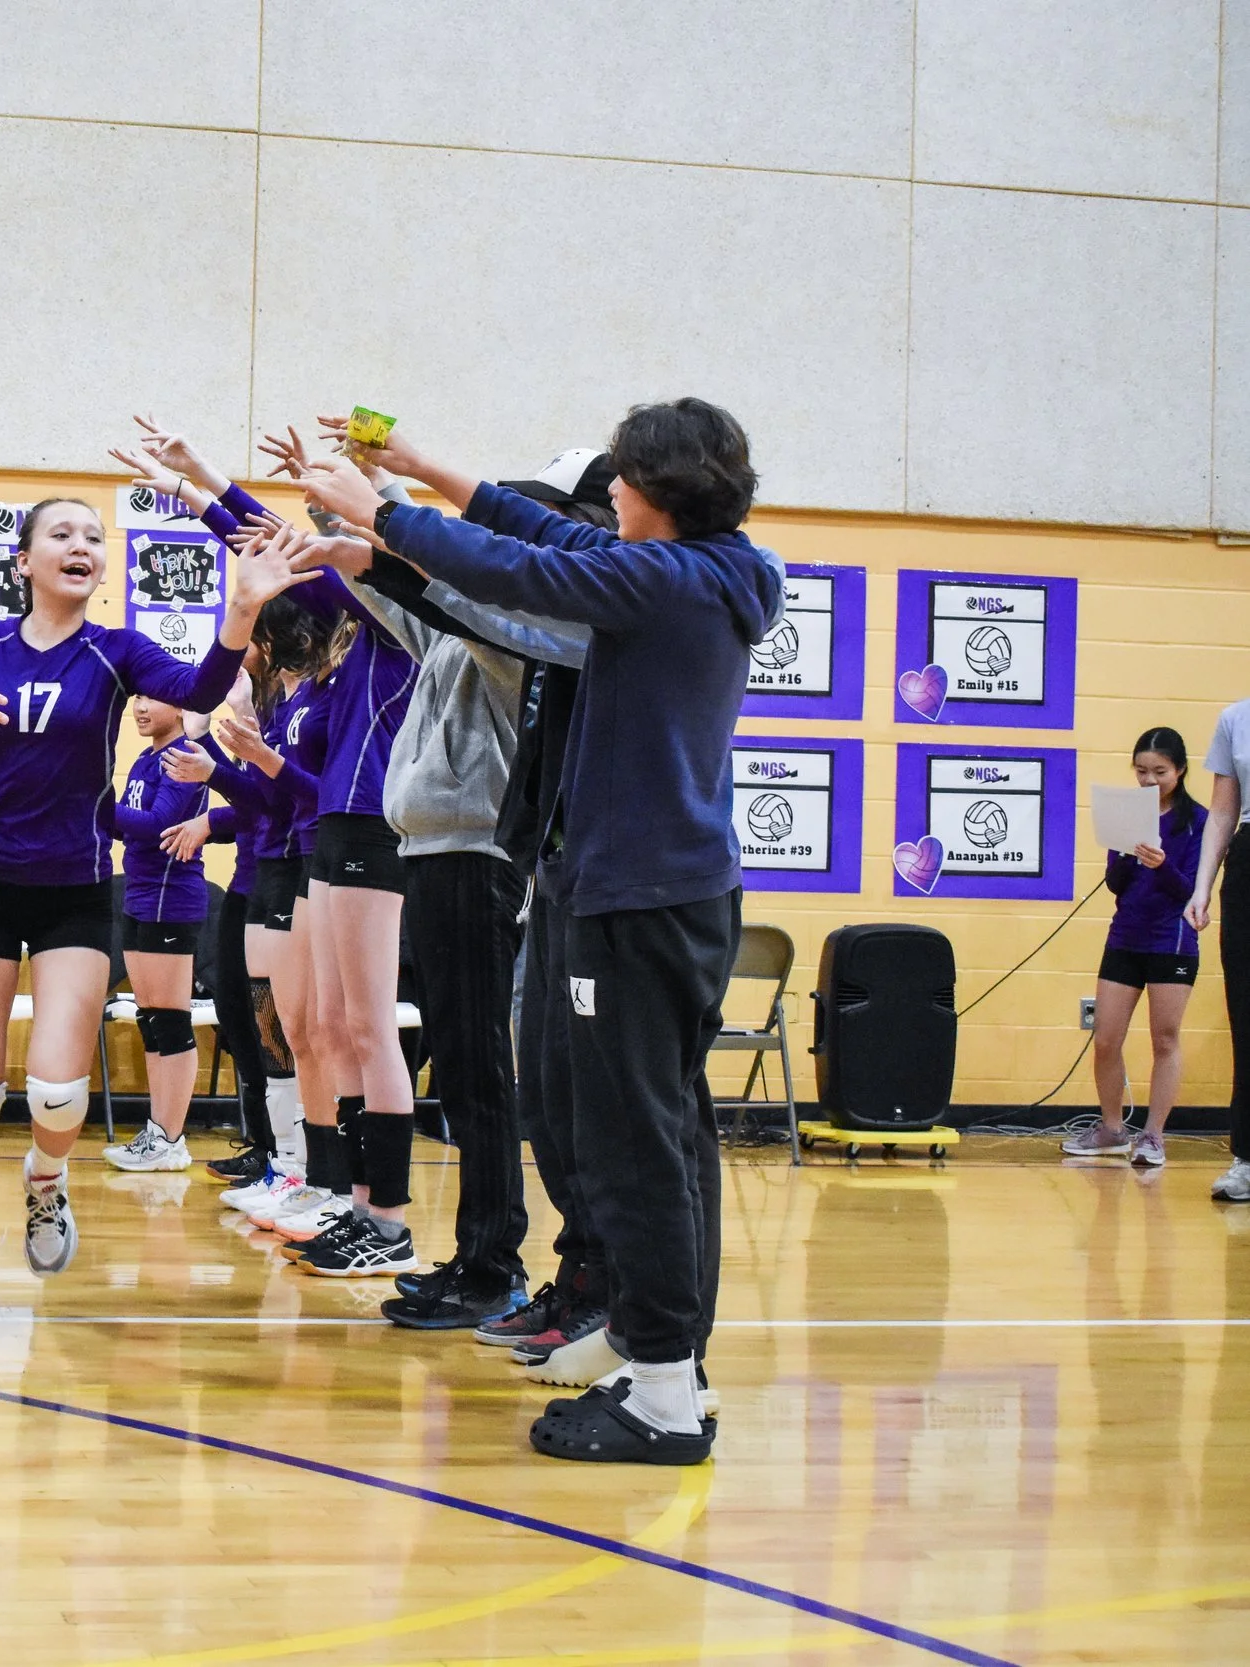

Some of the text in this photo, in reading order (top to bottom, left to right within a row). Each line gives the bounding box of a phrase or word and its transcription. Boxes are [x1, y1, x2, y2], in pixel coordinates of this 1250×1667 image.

[150, 548, 199, 576] thank
[158, 569, 201, 598] you!
[978, 597, 1002, 613] NGS
[750, 672, 802, 685] ada #16
[957, 679, 1019, 693] Emily #15
[17, 681, 62, 733] 17
[761, 762, 786, 777] NGS
[975, 767, 999, 782] NGS
[790, 845, 813, 856] #39
[947, 850, 1024, 864] Ananyah #19
